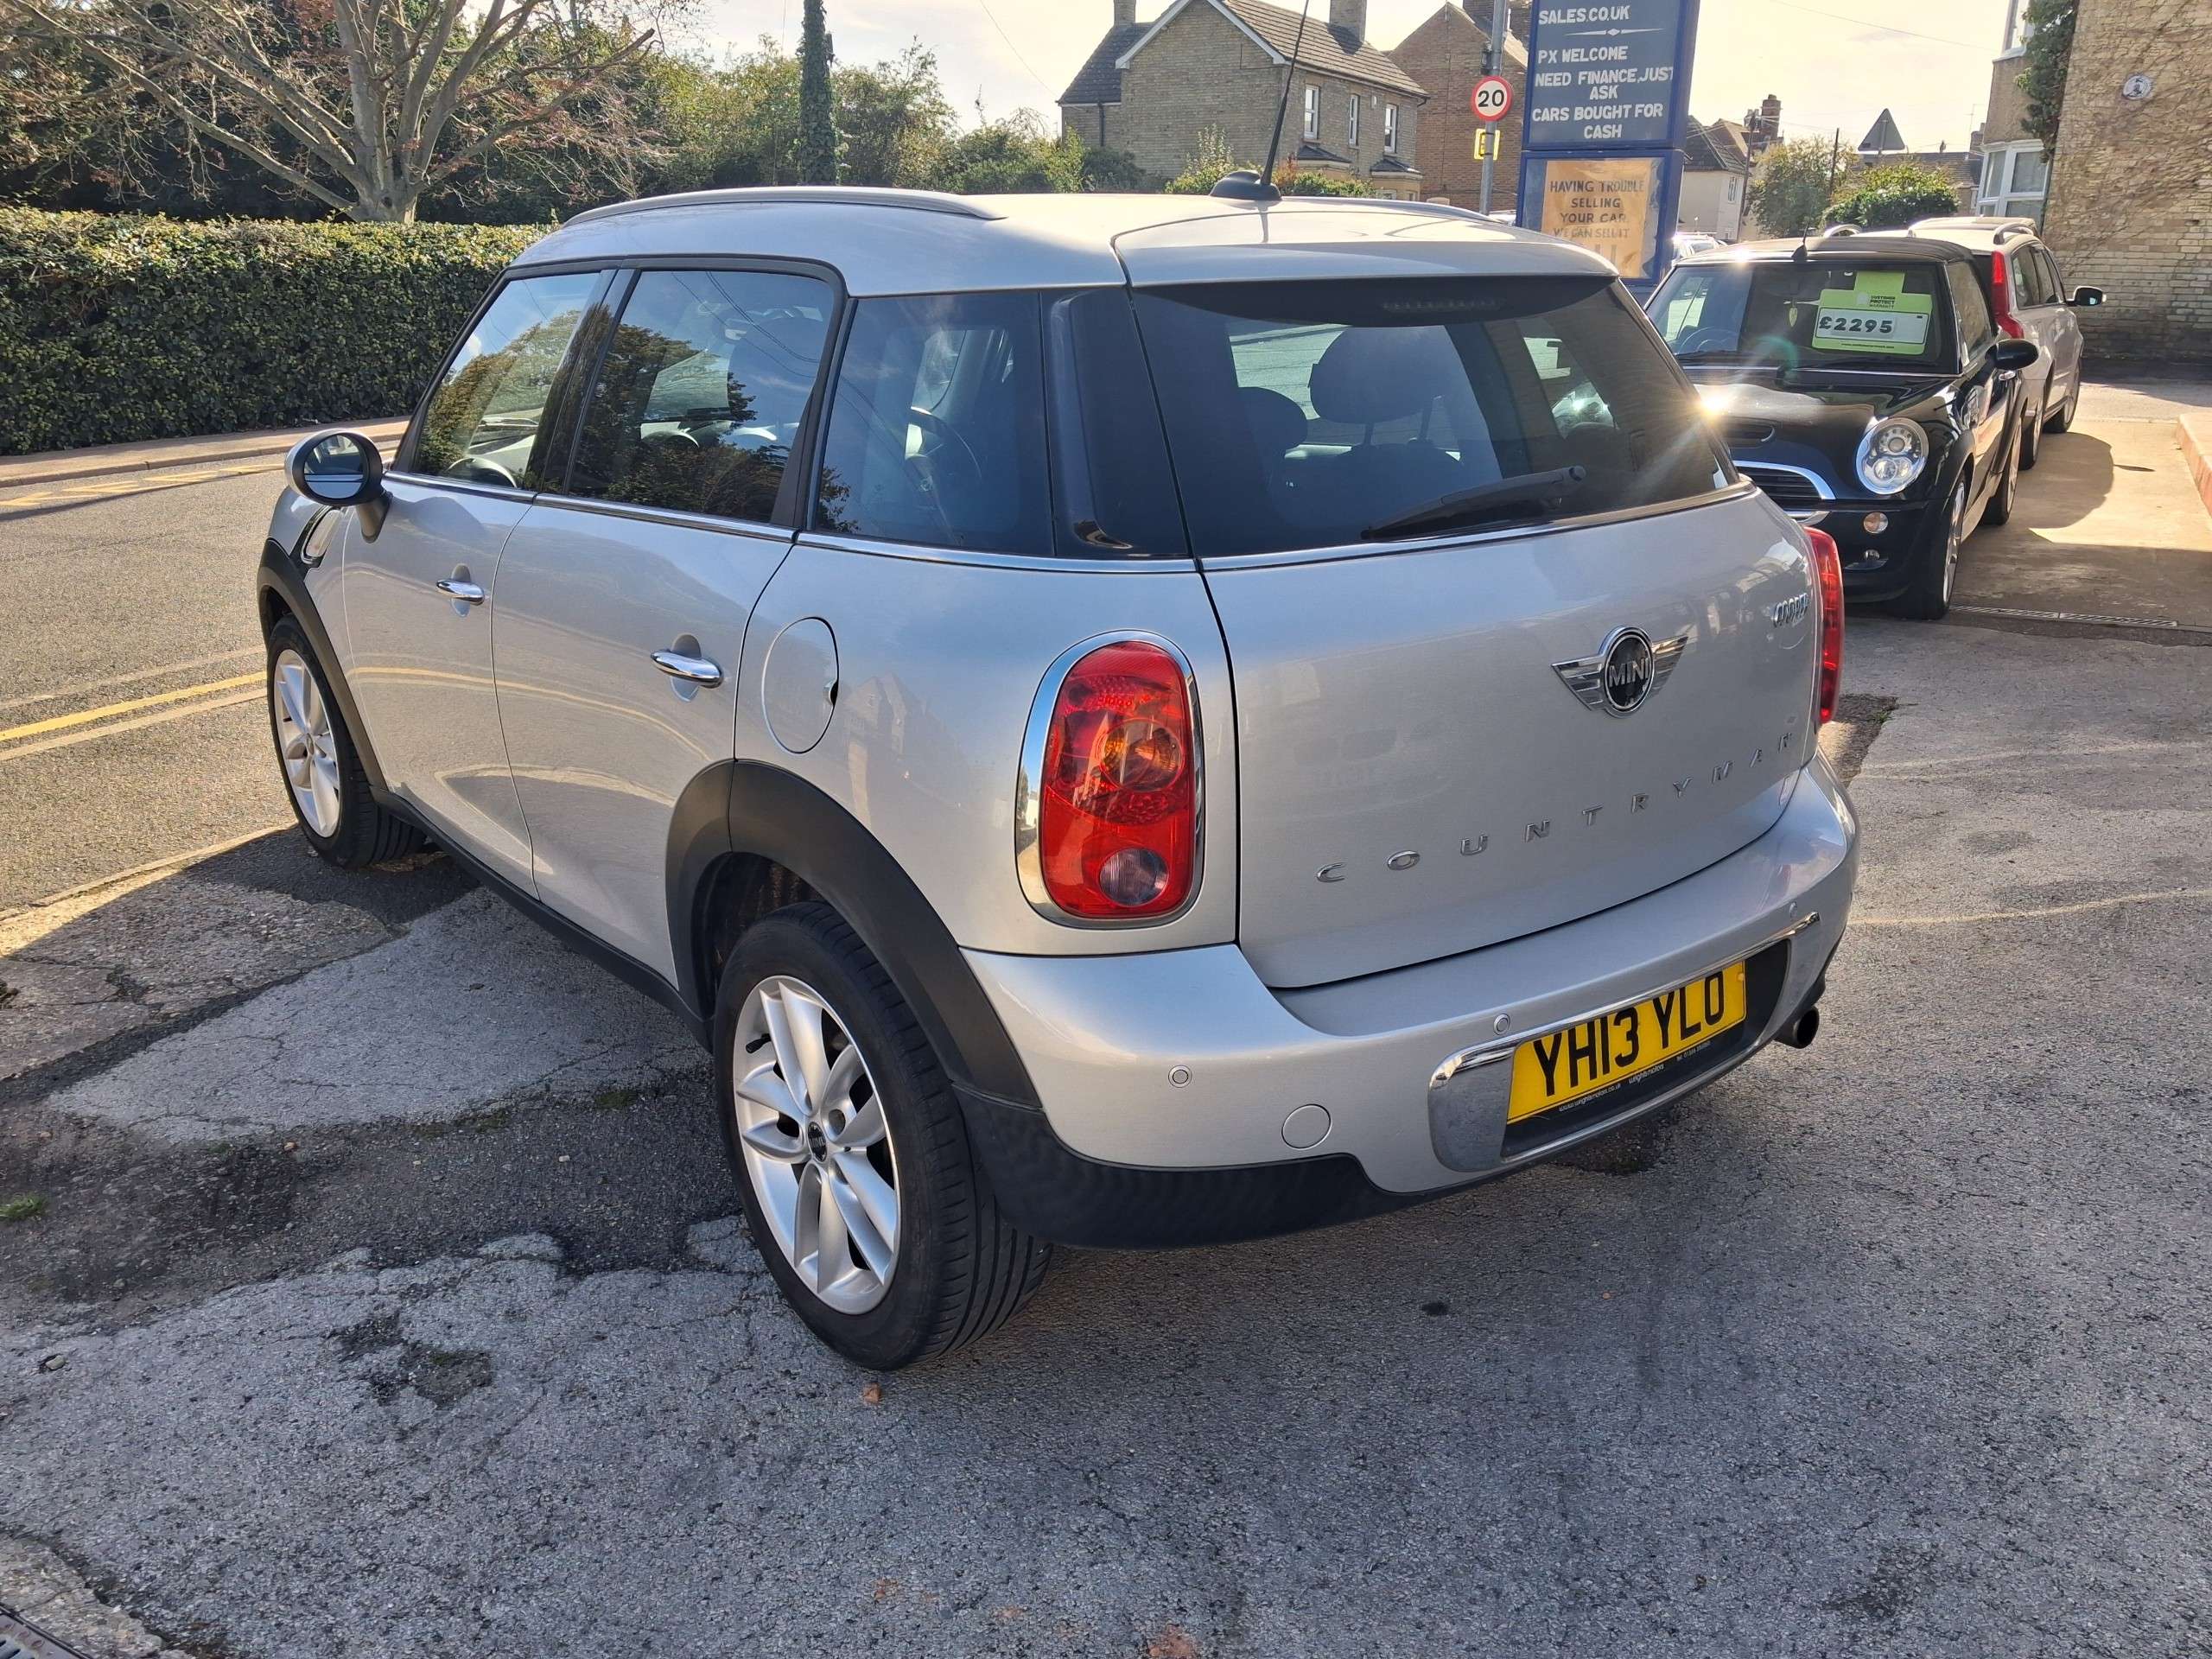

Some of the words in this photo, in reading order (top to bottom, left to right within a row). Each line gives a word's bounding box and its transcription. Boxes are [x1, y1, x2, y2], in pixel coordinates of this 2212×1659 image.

[1538, 5, 1630, 25] SALES.CO.UK
[1538, 50, 1558, 64] PX
[1561, 46, 1628, 63] WELCOME
[1535, 72, 1571, 86] NEED
[1478, 89, 1504, 107] 20
[1590, 86, 1618, 100] ASK
[1532, 107, 1570, 121] CARS
[1573, 105, 1632, 120] BOUGHT
[1634, 103, 1663, 118] FOR
[1584, 124, 1622, 138] CASH
[1550, 181, 1594, 192] HAVING
[1599, 180, 1644, 192] TROUBLE
[1571, 198, 1621, 207] SELLING
[1560, 213, 1594, 223] YOUR
[1819, 316, 1892, 334] £2295
[1608, 658, 1652, 688] MINI
[1533, 1009, 1640, 1097] YH13
[1651, 970, 1725, 1050] YLO
